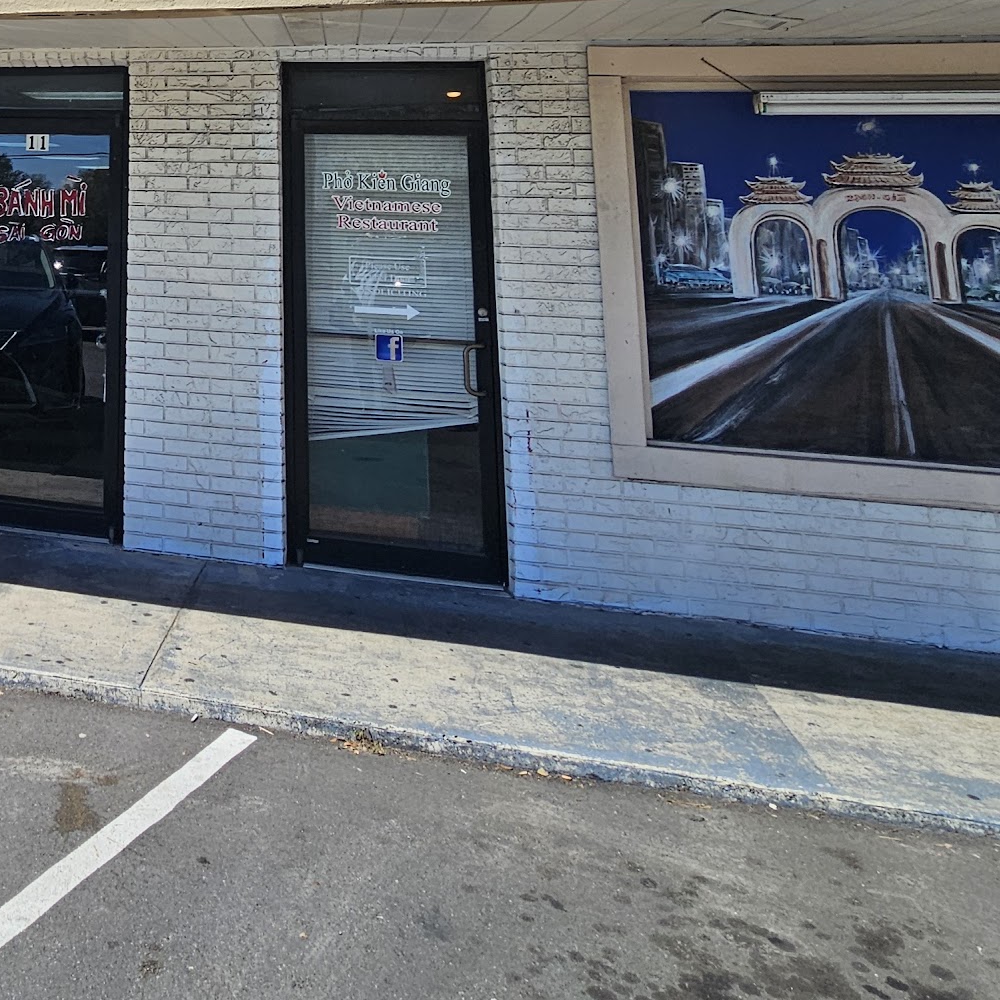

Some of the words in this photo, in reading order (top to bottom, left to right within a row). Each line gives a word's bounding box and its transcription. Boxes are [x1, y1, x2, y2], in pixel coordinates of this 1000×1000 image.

[28, 135, 47, 150] 11
[400, 172, 452, 198] Giang
[331, 195, 443, 214] Vietnamese
[336, 213, 440, 232] Restaurant
